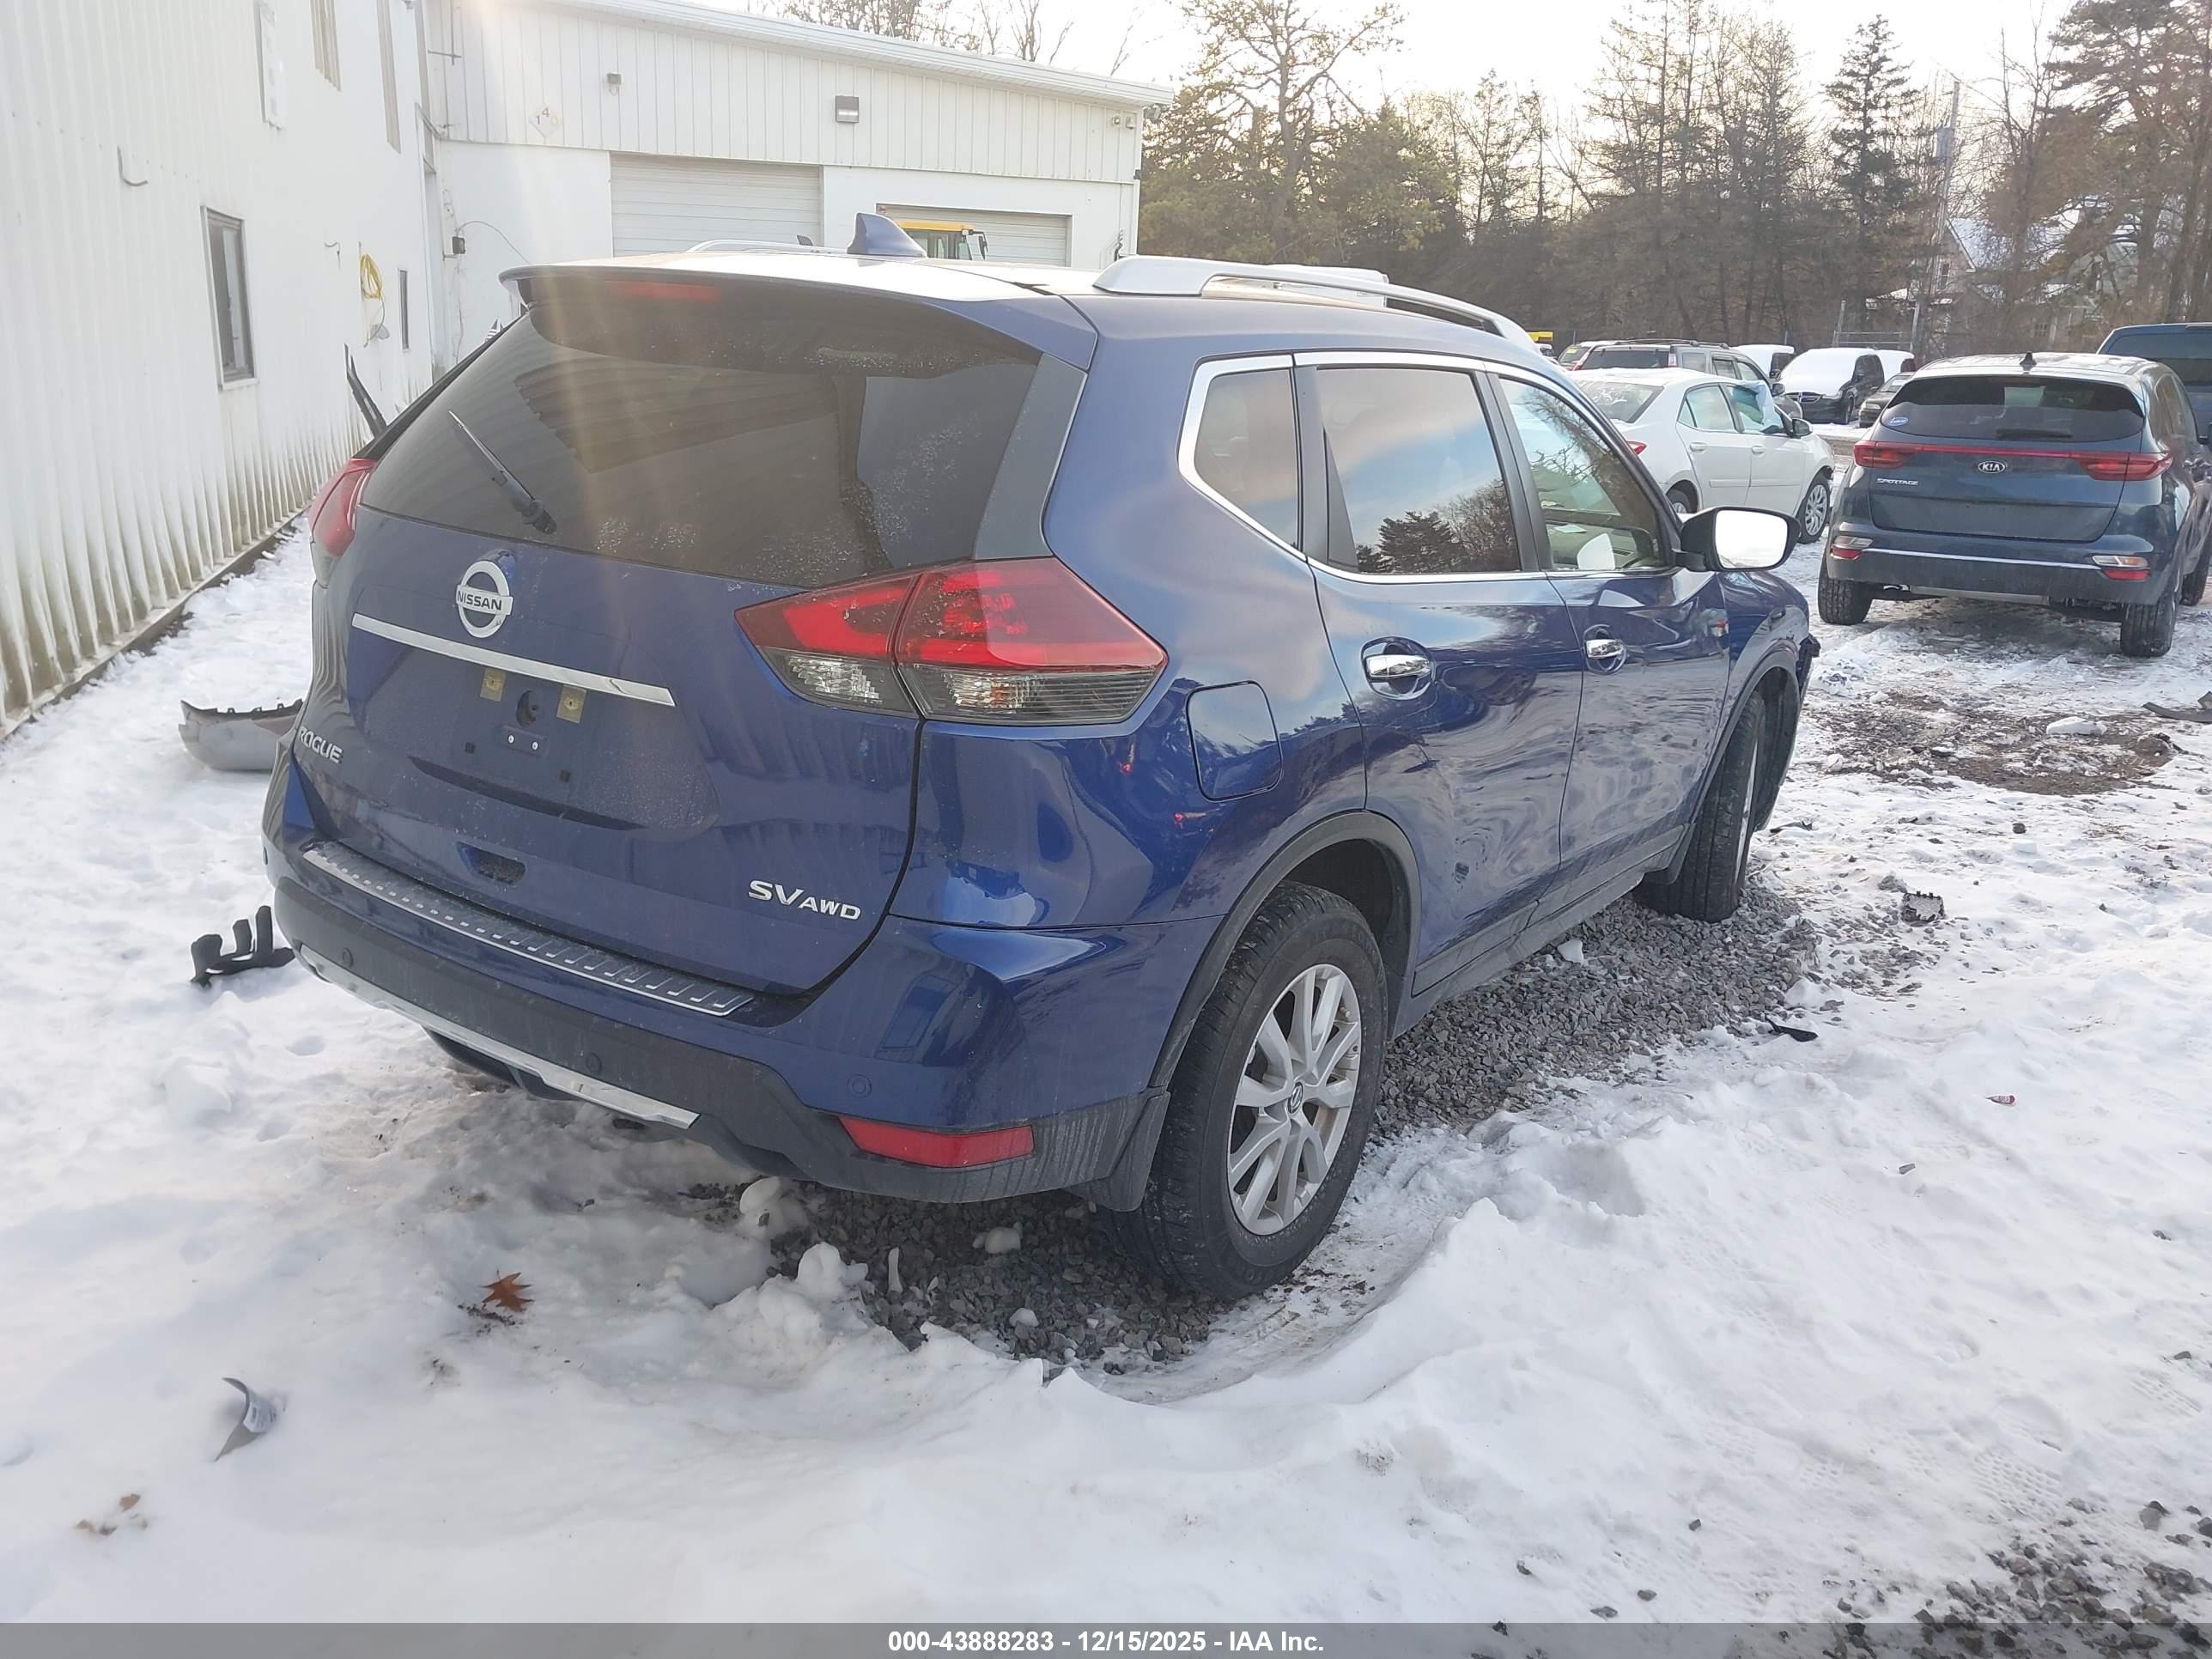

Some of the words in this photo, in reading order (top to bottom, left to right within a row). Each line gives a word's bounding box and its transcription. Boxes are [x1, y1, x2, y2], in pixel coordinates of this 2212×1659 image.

[542, 107, 550, 118] 4
[535, 115, 541, 125] 1
[1982, 462, 2001, 471] KIA
[1876, 477, 1919, 486] SPORTAGE
[457, 590, 502, 611] NISSAN
[299, 726, 343, 764] ROGUE
